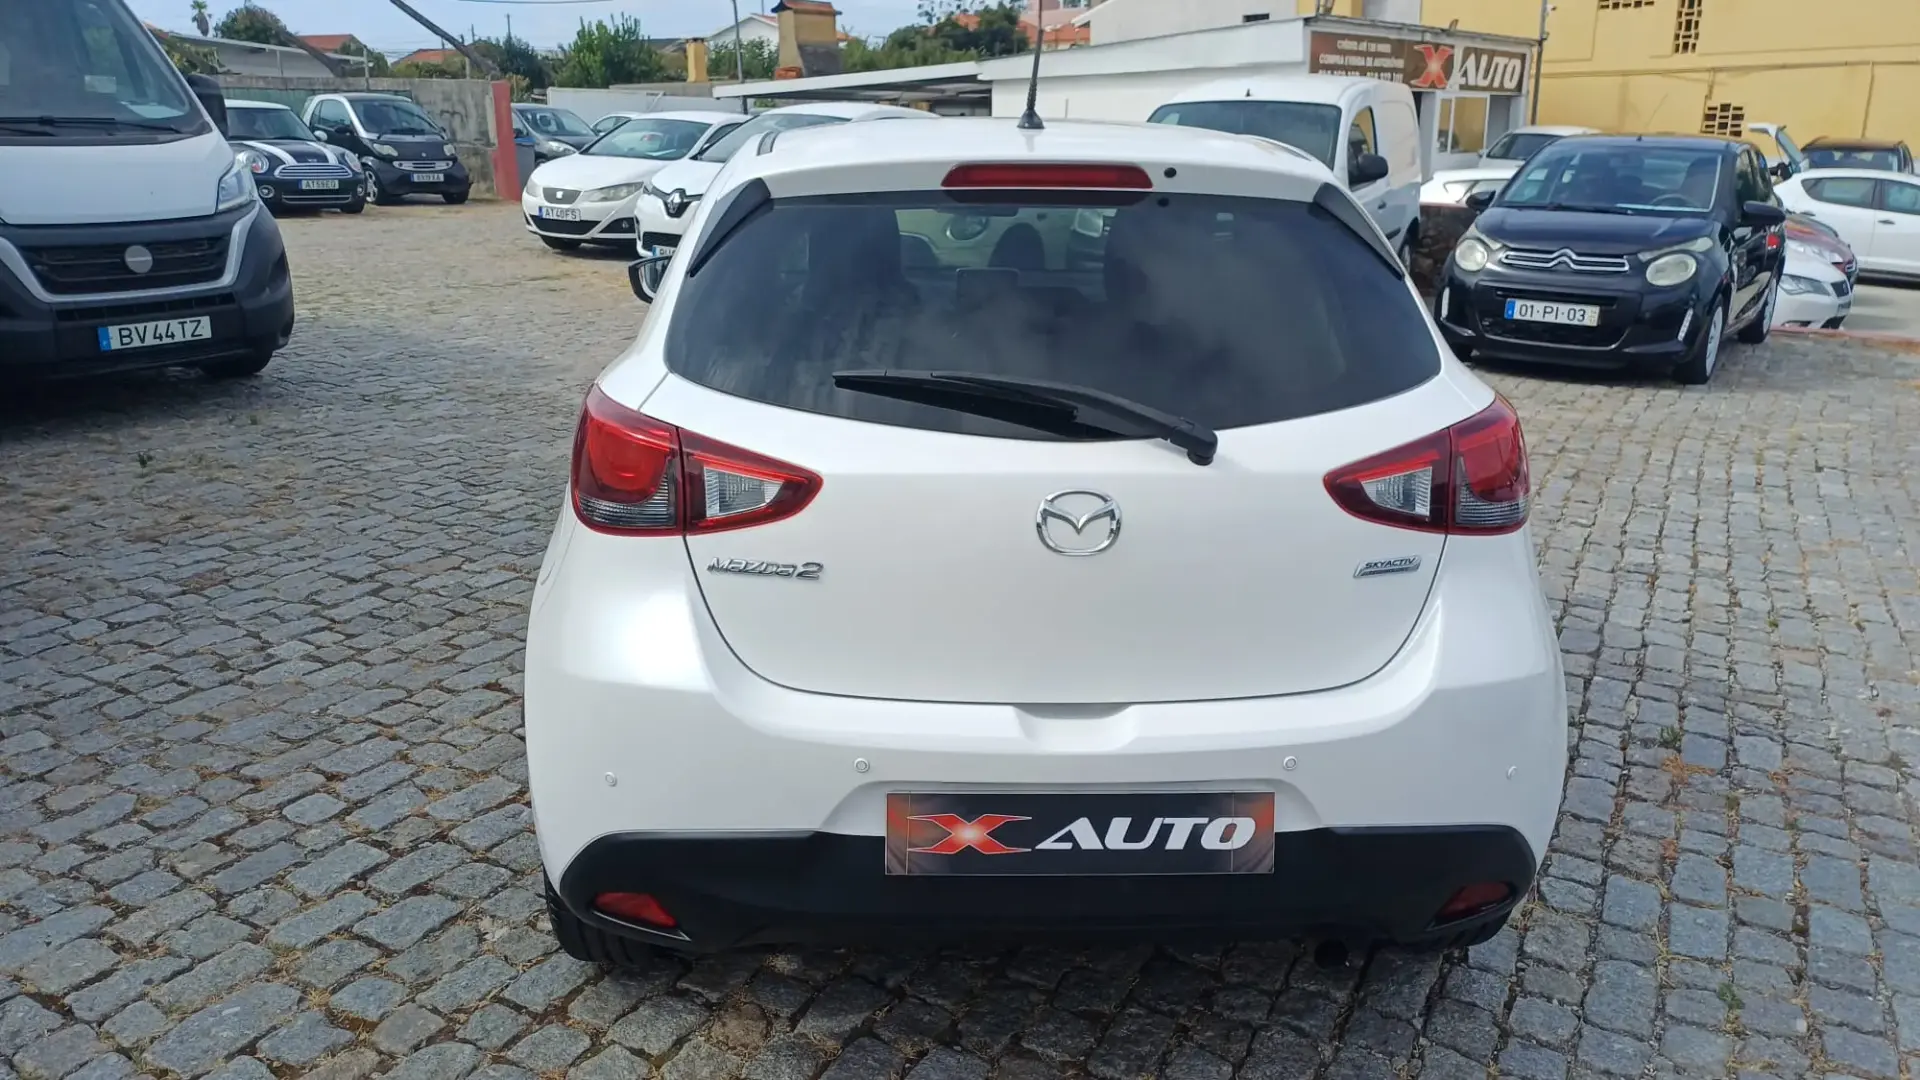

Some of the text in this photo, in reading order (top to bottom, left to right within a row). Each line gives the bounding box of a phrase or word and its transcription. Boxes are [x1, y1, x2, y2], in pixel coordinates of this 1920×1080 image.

[1410, 44, 1522, 89] X AUTO
[1365, 557, 1416, 569] SKYACTIV
[907, 814, 1256, 854] X AUTO
